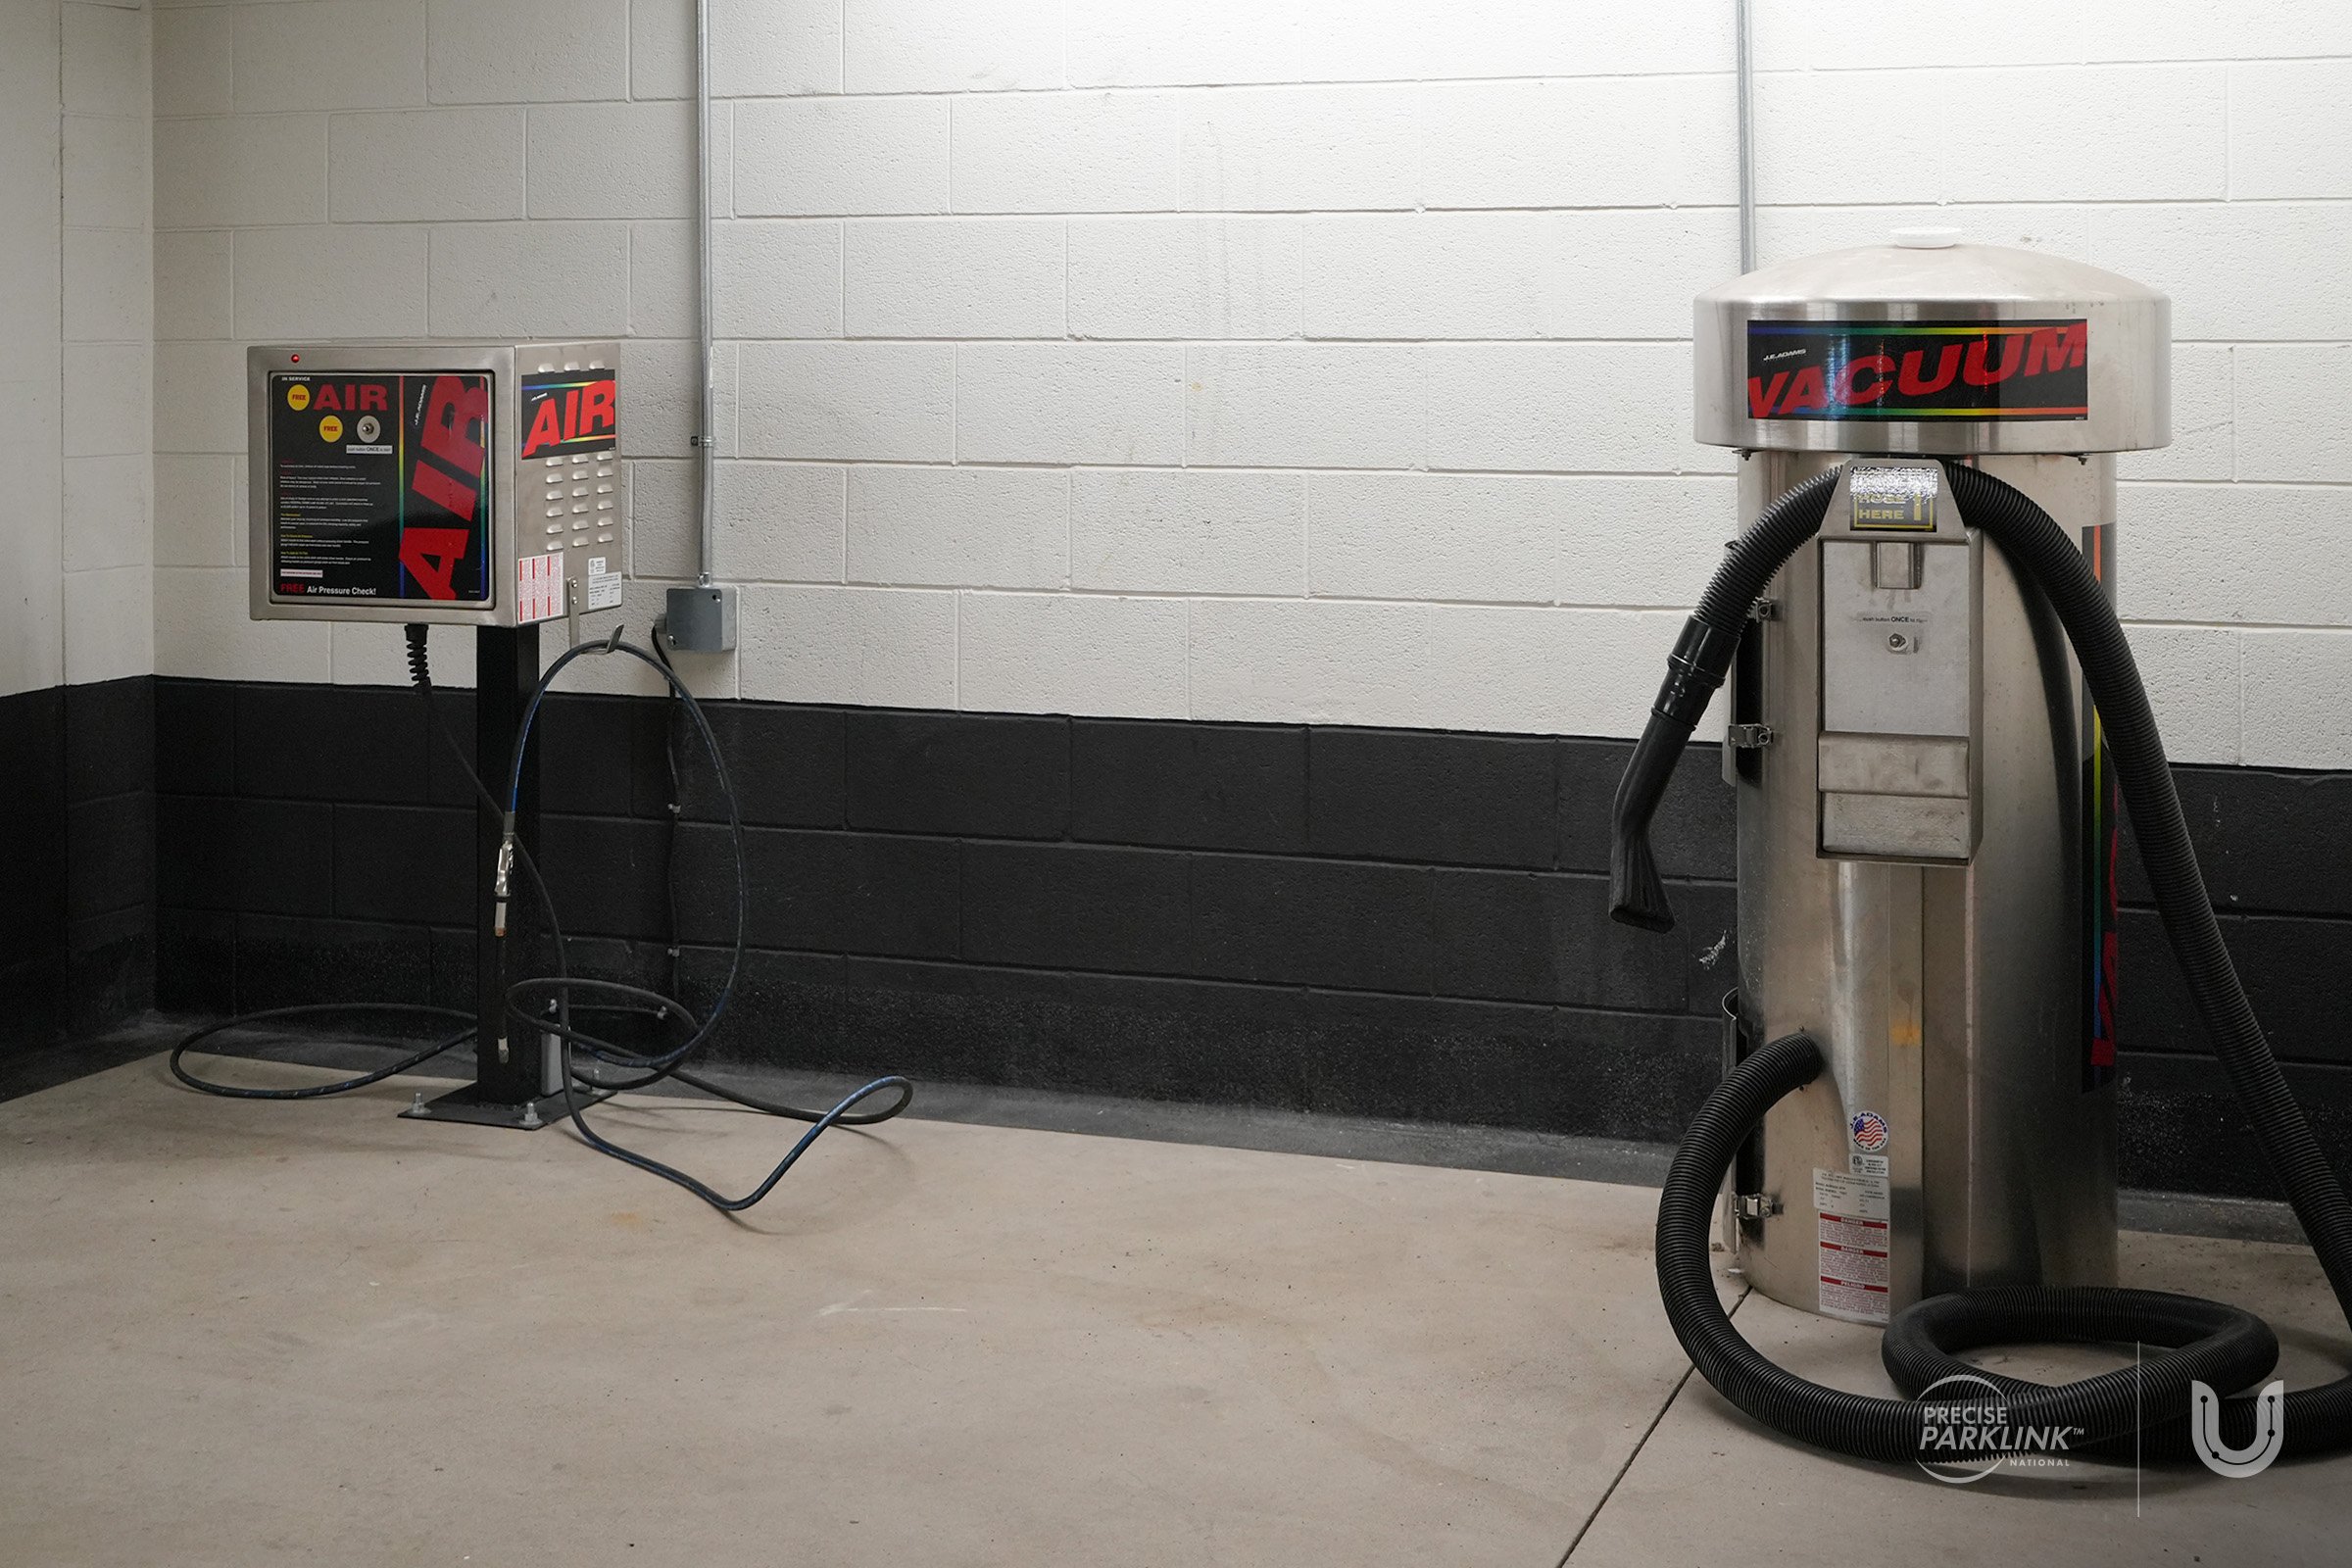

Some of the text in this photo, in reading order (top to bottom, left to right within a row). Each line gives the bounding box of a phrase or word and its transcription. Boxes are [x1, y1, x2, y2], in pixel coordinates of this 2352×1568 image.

[1747, 321, 2087, 419] VACUUM
[314, 384, 388, 411] AIR
[521, 379, 615, 458] AIR
[399, 376, 489, 601] AIR
[1858, 509, 1904, 519] HERE
[280, 583, 376, 596] FREE Air Pressure Check!
[1840, 1217, 1864, 1226] DANGER
[1840, 1246, 1864, 1254] DANGER
[1840, 1280, 1866, 1290] PELIGRO
